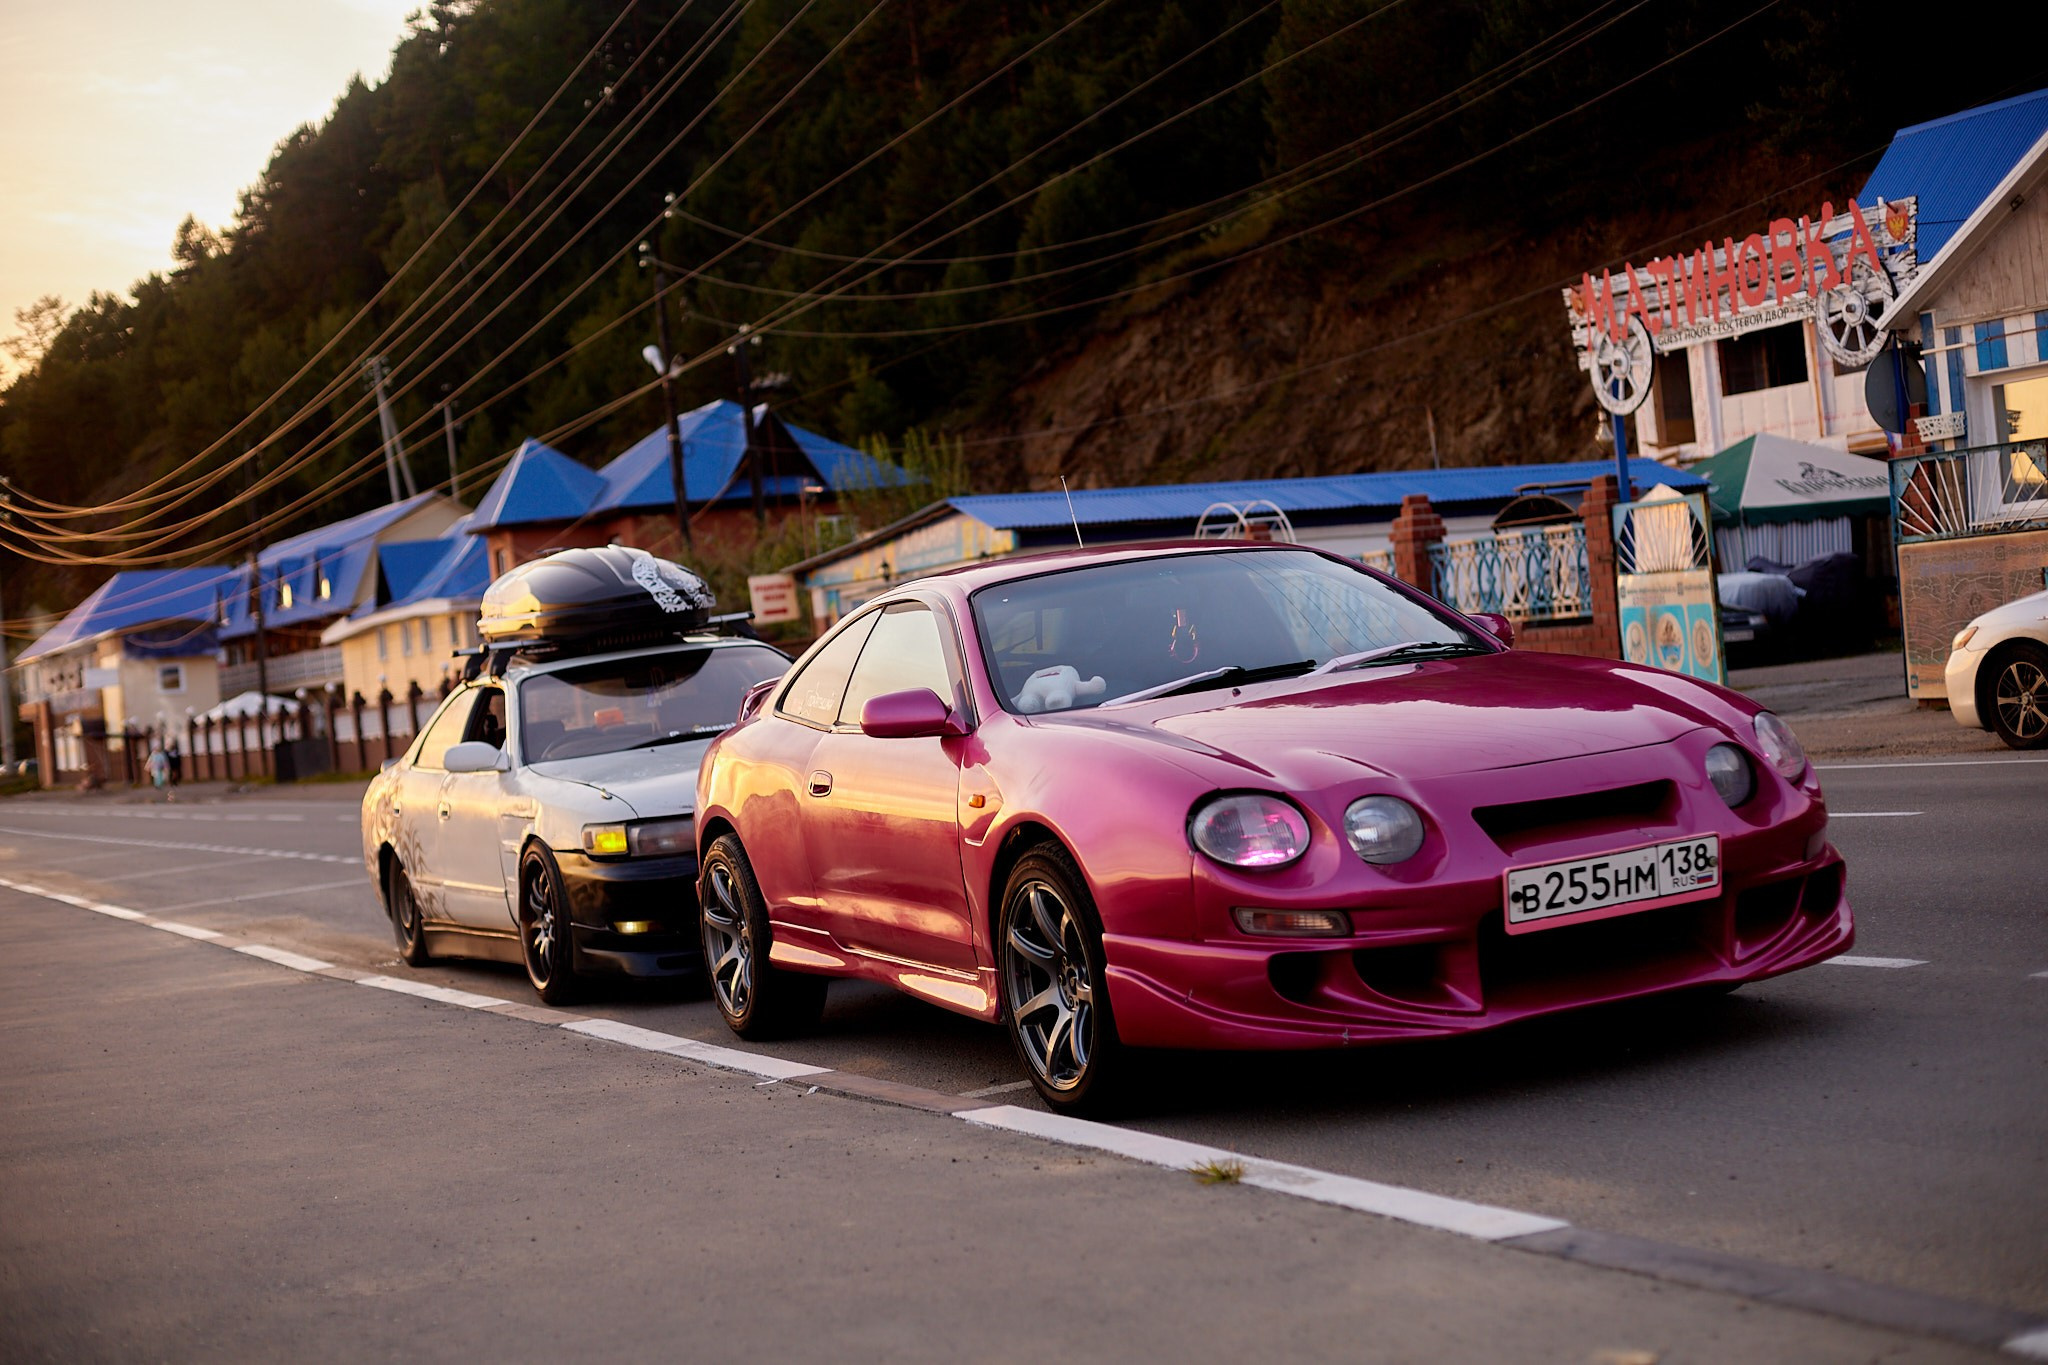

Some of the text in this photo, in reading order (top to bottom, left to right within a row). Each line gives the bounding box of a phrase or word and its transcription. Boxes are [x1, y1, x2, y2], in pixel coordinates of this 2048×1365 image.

[1583, 198, 1881, 352] МАЛИНОВКА
[1717, 312, 1763, 333] ГОСТЕВОЙ
[1765, 306, 1790, 324] ДВОР
[1656, 324, 1711, 346] GUEST HOUSE
[1661, 843, 1709, 877] 138
[1672, 875, 1697, 889] RUS
